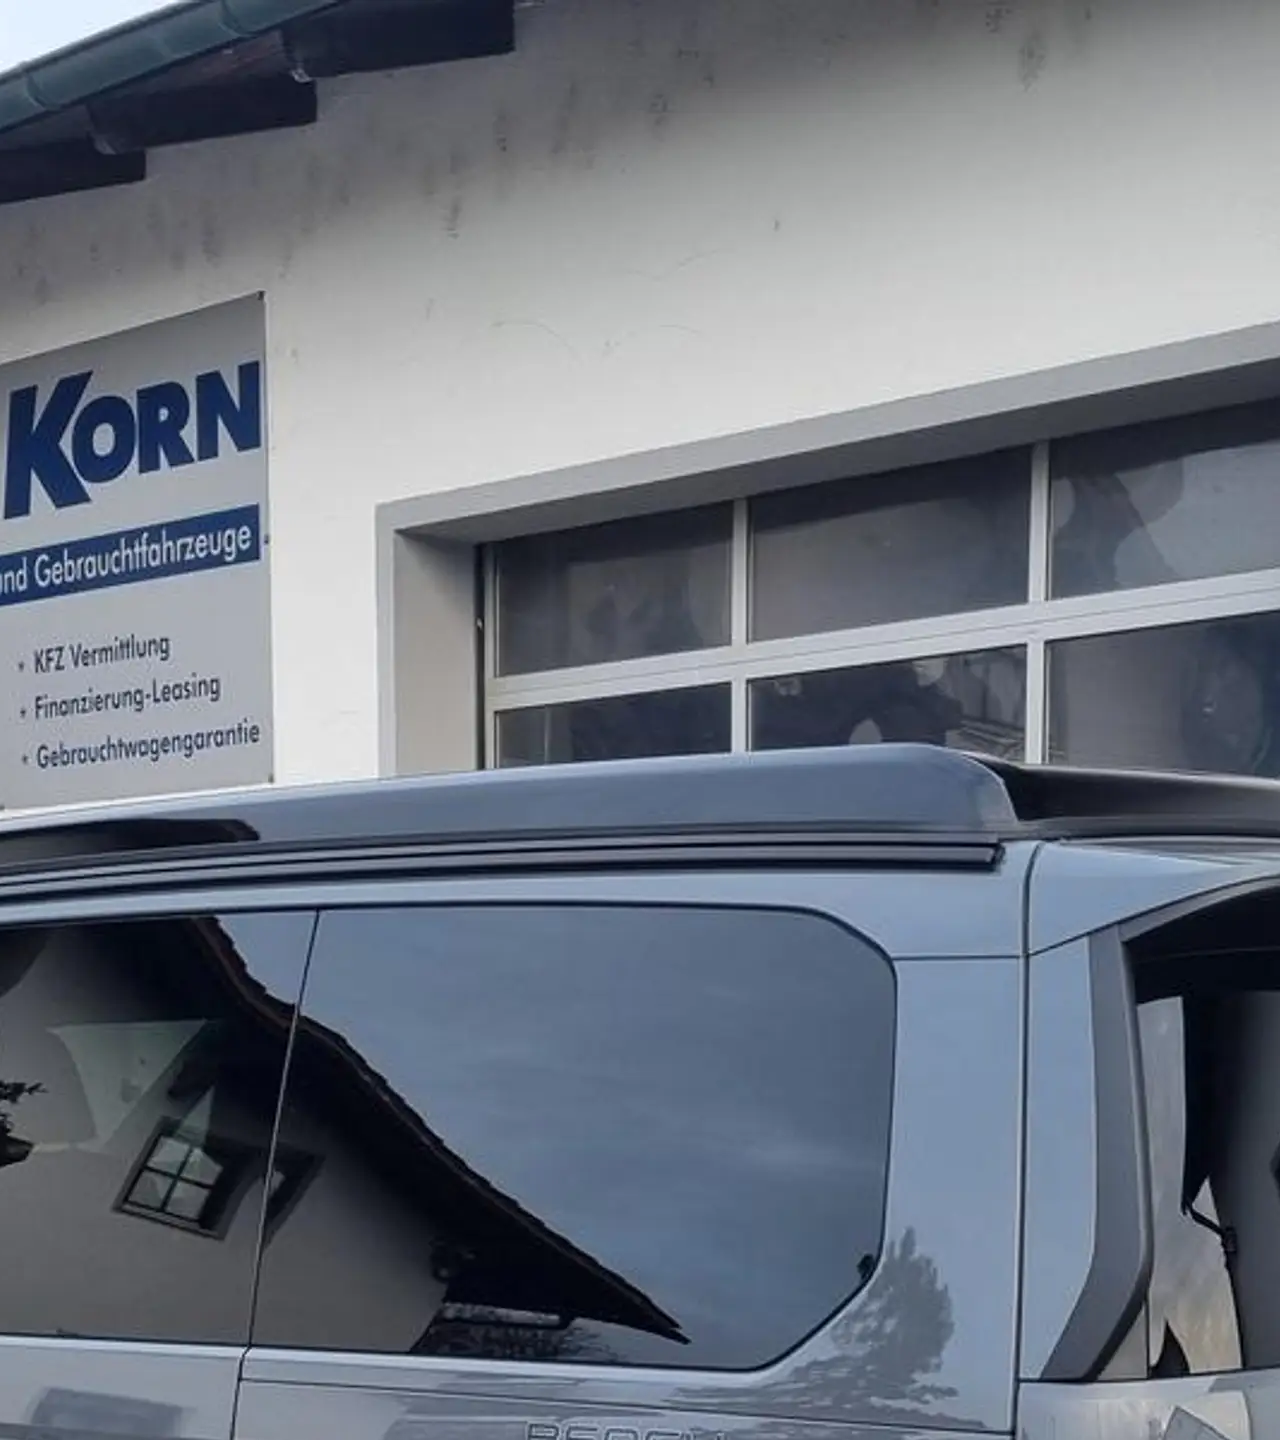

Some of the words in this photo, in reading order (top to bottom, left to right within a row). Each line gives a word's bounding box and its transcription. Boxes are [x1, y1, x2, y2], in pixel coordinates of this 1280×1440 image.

[4, 361, 261, 519] KORN
[35, 524, 252, 588] Gebrauchtfahrzeuge
[34, 646, 65, 673] KFZ
[69, 634, 171, 668] Vermittlung
[35, 672, 221, 720] Finanzierung-Leasing
[36, 718, 261, 769] Gebrauchtwagengarantie
